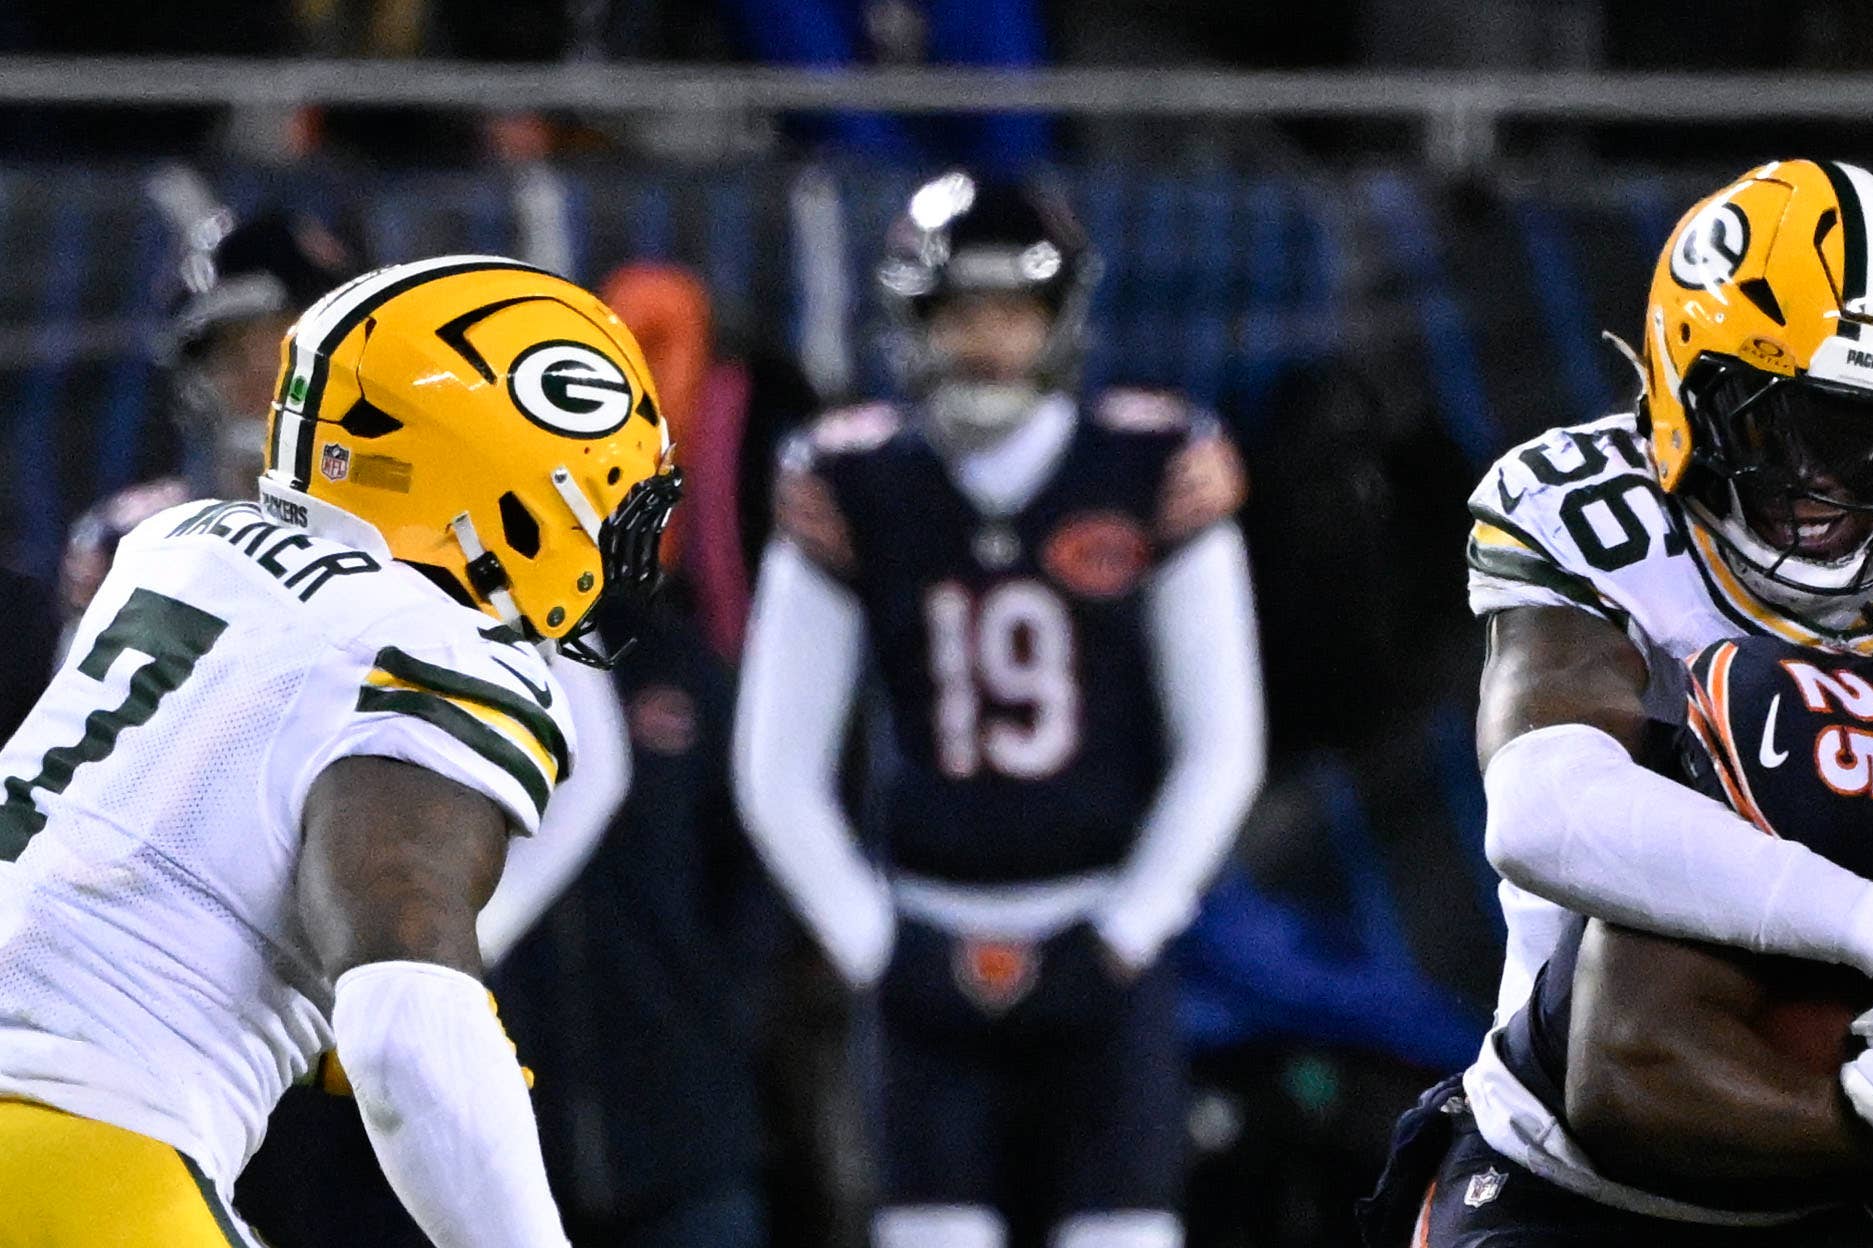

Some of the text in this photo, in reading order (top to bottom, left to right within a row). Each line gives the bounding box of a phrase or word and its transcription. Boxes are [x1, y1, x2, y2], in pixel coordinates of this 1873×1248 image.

[506, 339, 633, 440] G
[1518, 427, 1690, 573] 56
[925, 577, 1081, 779] 19
